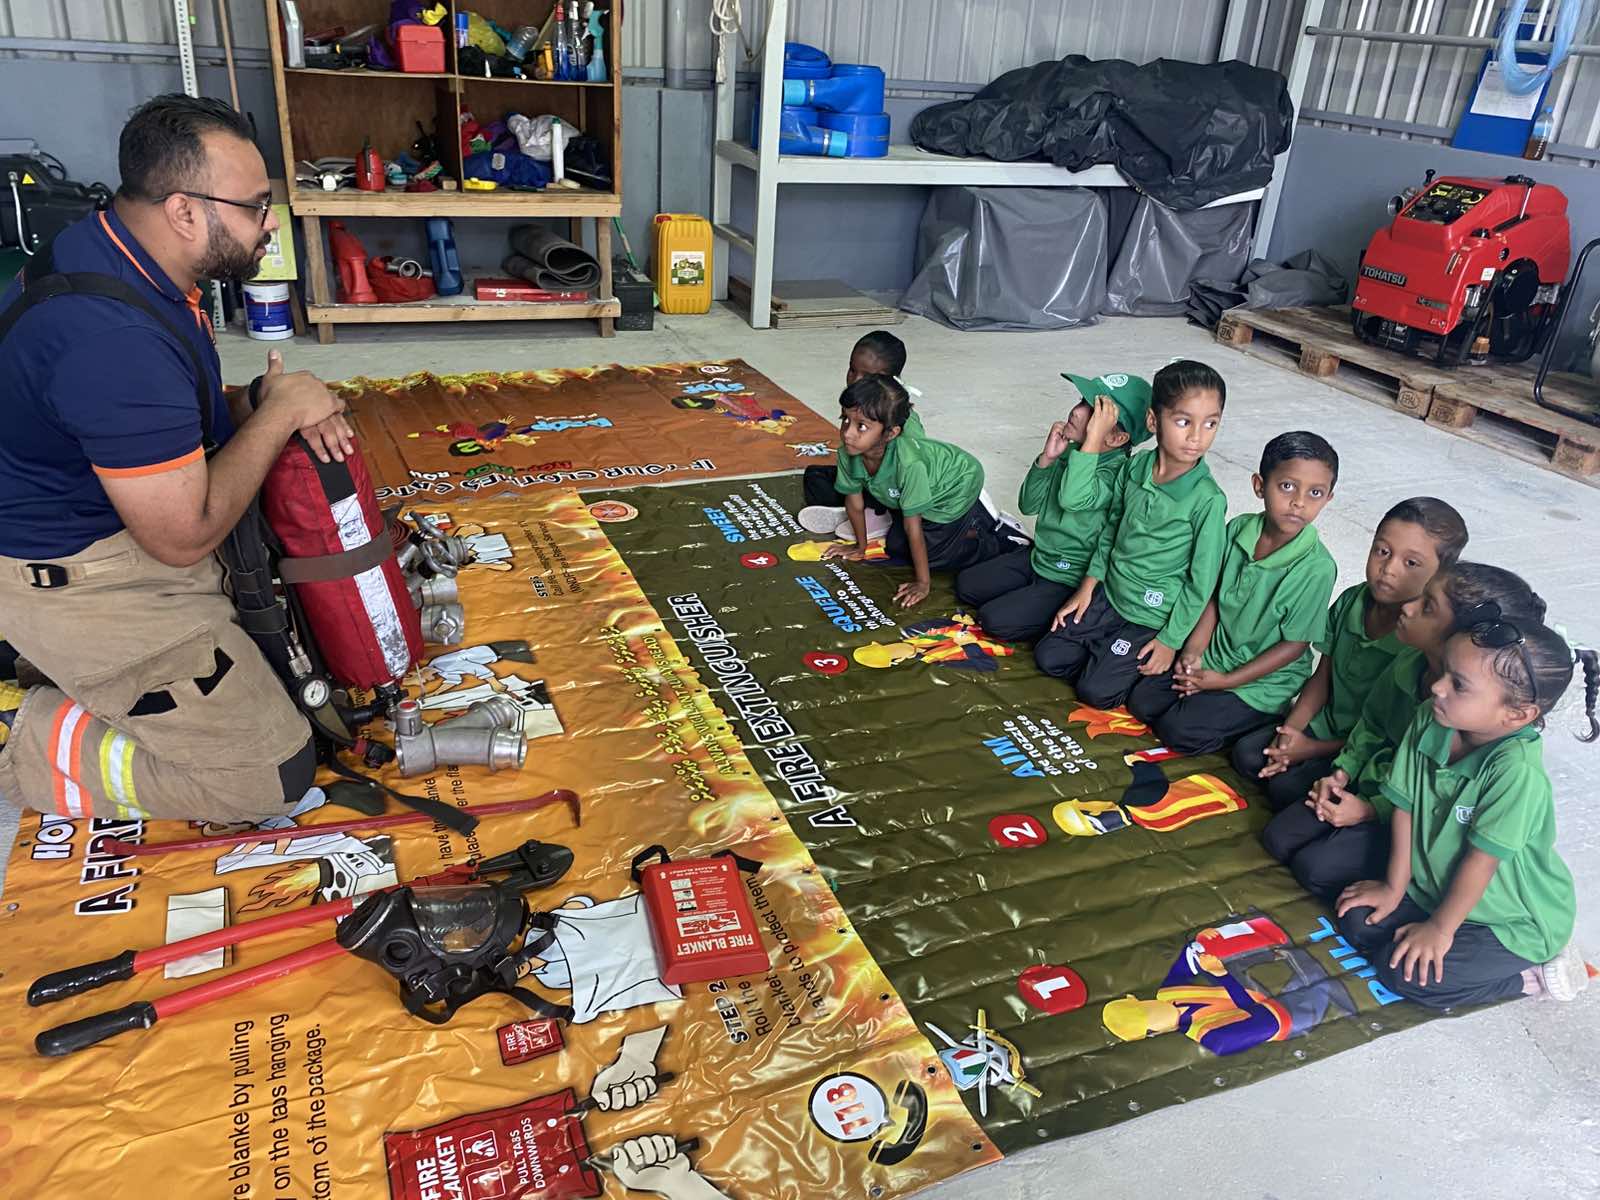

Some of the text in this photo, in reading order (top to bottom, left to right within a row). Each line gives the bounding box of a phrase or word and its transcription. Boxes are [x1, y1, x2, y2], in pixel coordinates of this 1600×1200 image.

[1363, 266, 1406, 285] TOHATSU
[456, 440, 481, 454] 2
[374, 480, 455, 500] CATC
[703, 506, 746, 543] SWEEP
[747, 554, 769, 565] 4
[825, 562, 848, 582] agent
[794, 575, 862, 633] SQUEEZE
[846, 577, 861, 595] the
[836, 590, 881, 631] th lever to
[813, 658, 839, 668] 3
[667, 592, 857, 828] A FIRE EXTINGUISHER
[676, 690, 709, 737] VIGILANT
[700, 733, 736, 775] ALWAYS
[982, 735, 1046, 777] AIM
[1003, 720, 1062, 776] the nozzle
[1017, 714, 1081, 774] to the base
[1040, 718, 1098, 770] of the fire
[451, 779, 465, 795] the
[456, 797, 468, 807] er
[438, 834, 454, 861] have
[465, 831, 486, 861] place
[1002, 822, 1039, 841] 2
[75, 882, 136, 915] A
[676, 937, 728, 956] BLANKET
[727, 934, 754, 946] FIRE
[760, 910, 799, 955] protect
[789, 956, 805, 973] to
[1307, 915, 1405, 1006] PULL
[764, 974, 802, 1030] blanket
[1034, 976, 1071, 1000] 1
[708, 980, 749, 1045] STEP 2
[738, 980, 773, 1037] Roll the
[229, 1020, 255, 1079] pulling
[266, 1013, 291, 1082] hanging
[505, 1031, 517, 1052] FIRE
[228, 1083, 255, 1108] by
[826, 1082, 870, 1136] 118
[306, 1098, 327, 1131] the
[228, 1111, 250, 1181] blanke
[268, 1127, 290, 1162] the
[306, 1135, 328, 1156] of
[510, 1130, 530, 1185] PULL TABS
[521, 1117, 546, 1189] DOWNWARDS
[273, 1164, 291, 1190] on
[416, 1157, 443, 1200] FIRE
[435, 1135, 463, 1200] LANKET
